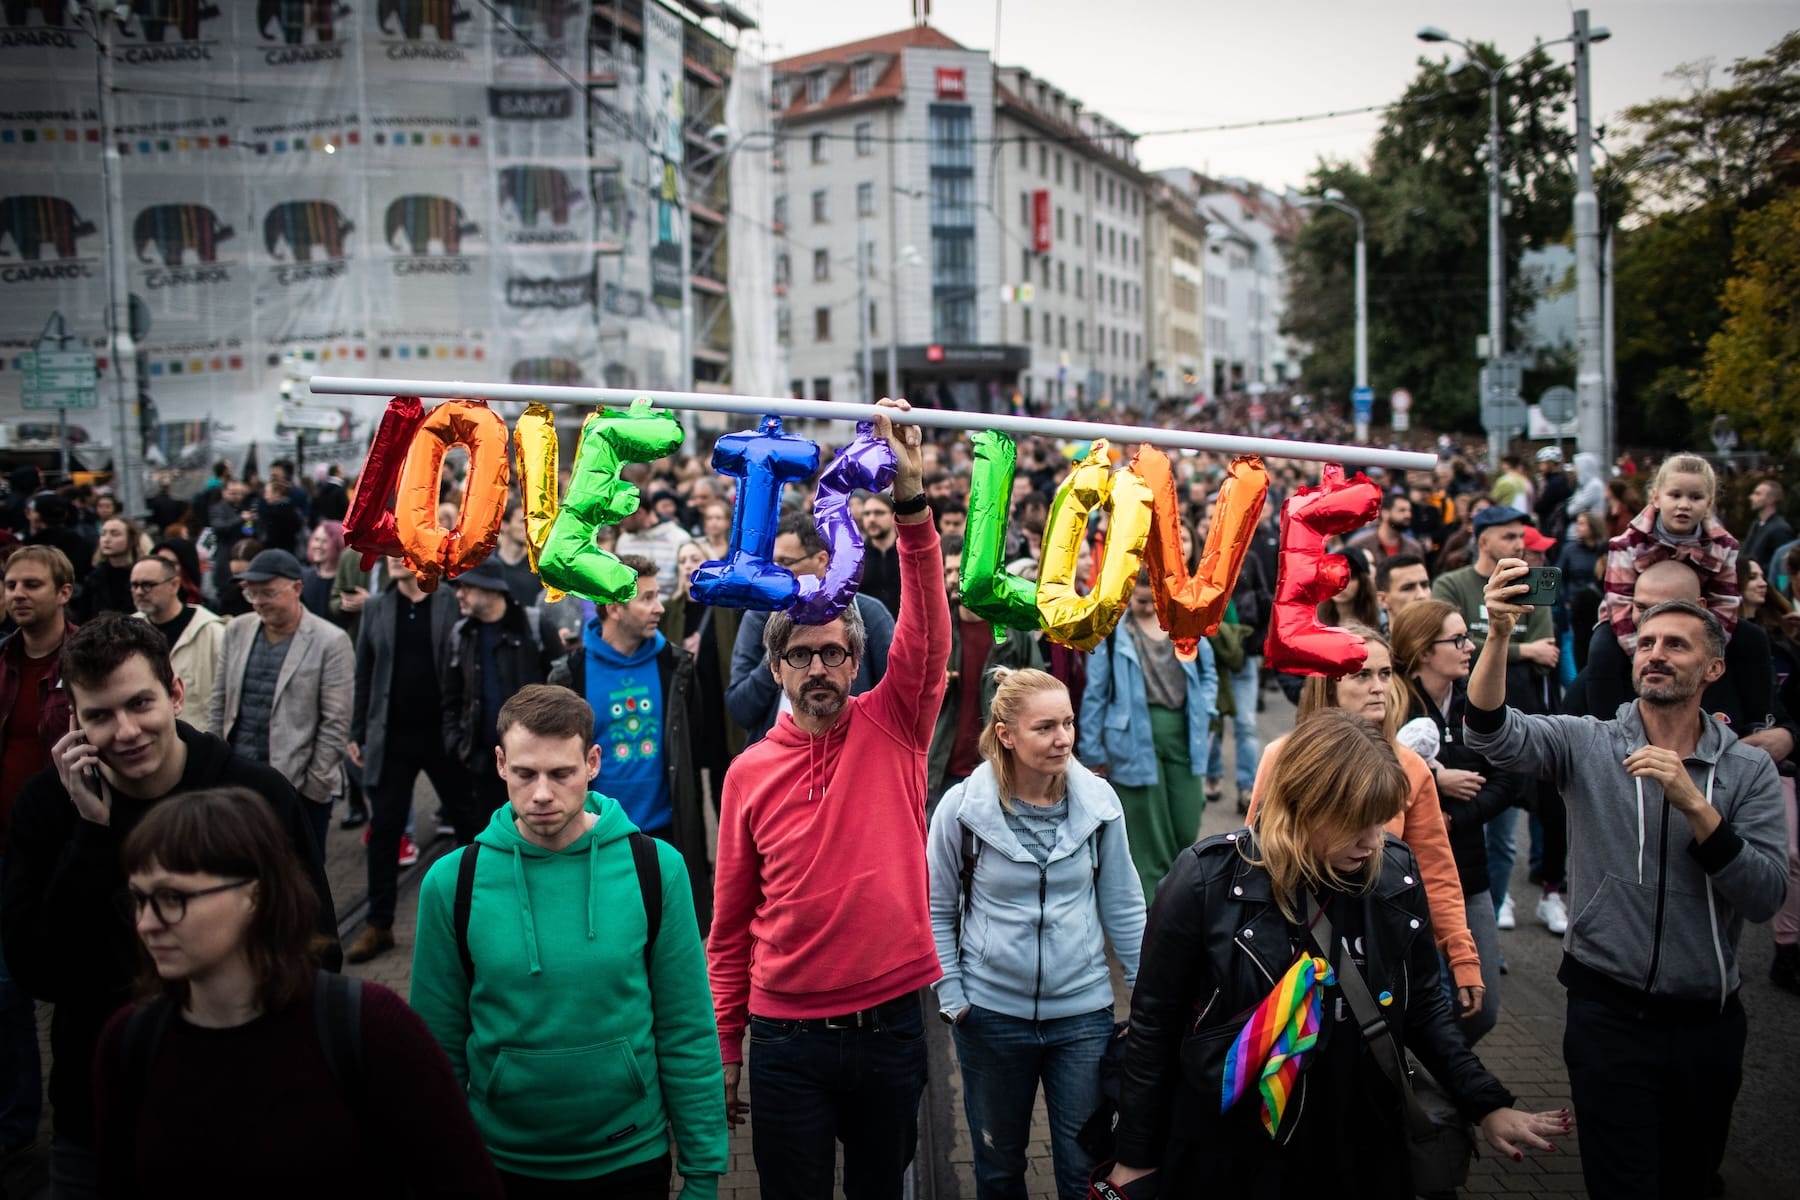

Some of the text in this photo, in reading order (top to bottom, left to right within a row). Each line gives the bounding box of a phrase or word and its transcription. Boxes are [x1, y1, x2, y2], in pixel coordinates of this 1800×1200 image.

[125, 46, 212, 64] CAPAROL
[265, 47, 343, 66] CAPAROL
[386, 46, 466, 62] CAPAROL
[2, 264, 93, 284] CAPAROL
[393, 259, 473, 277] CAPAROL
[690, 413, 897, 626] IS
[959, 429, 1382, 679] LOVE
